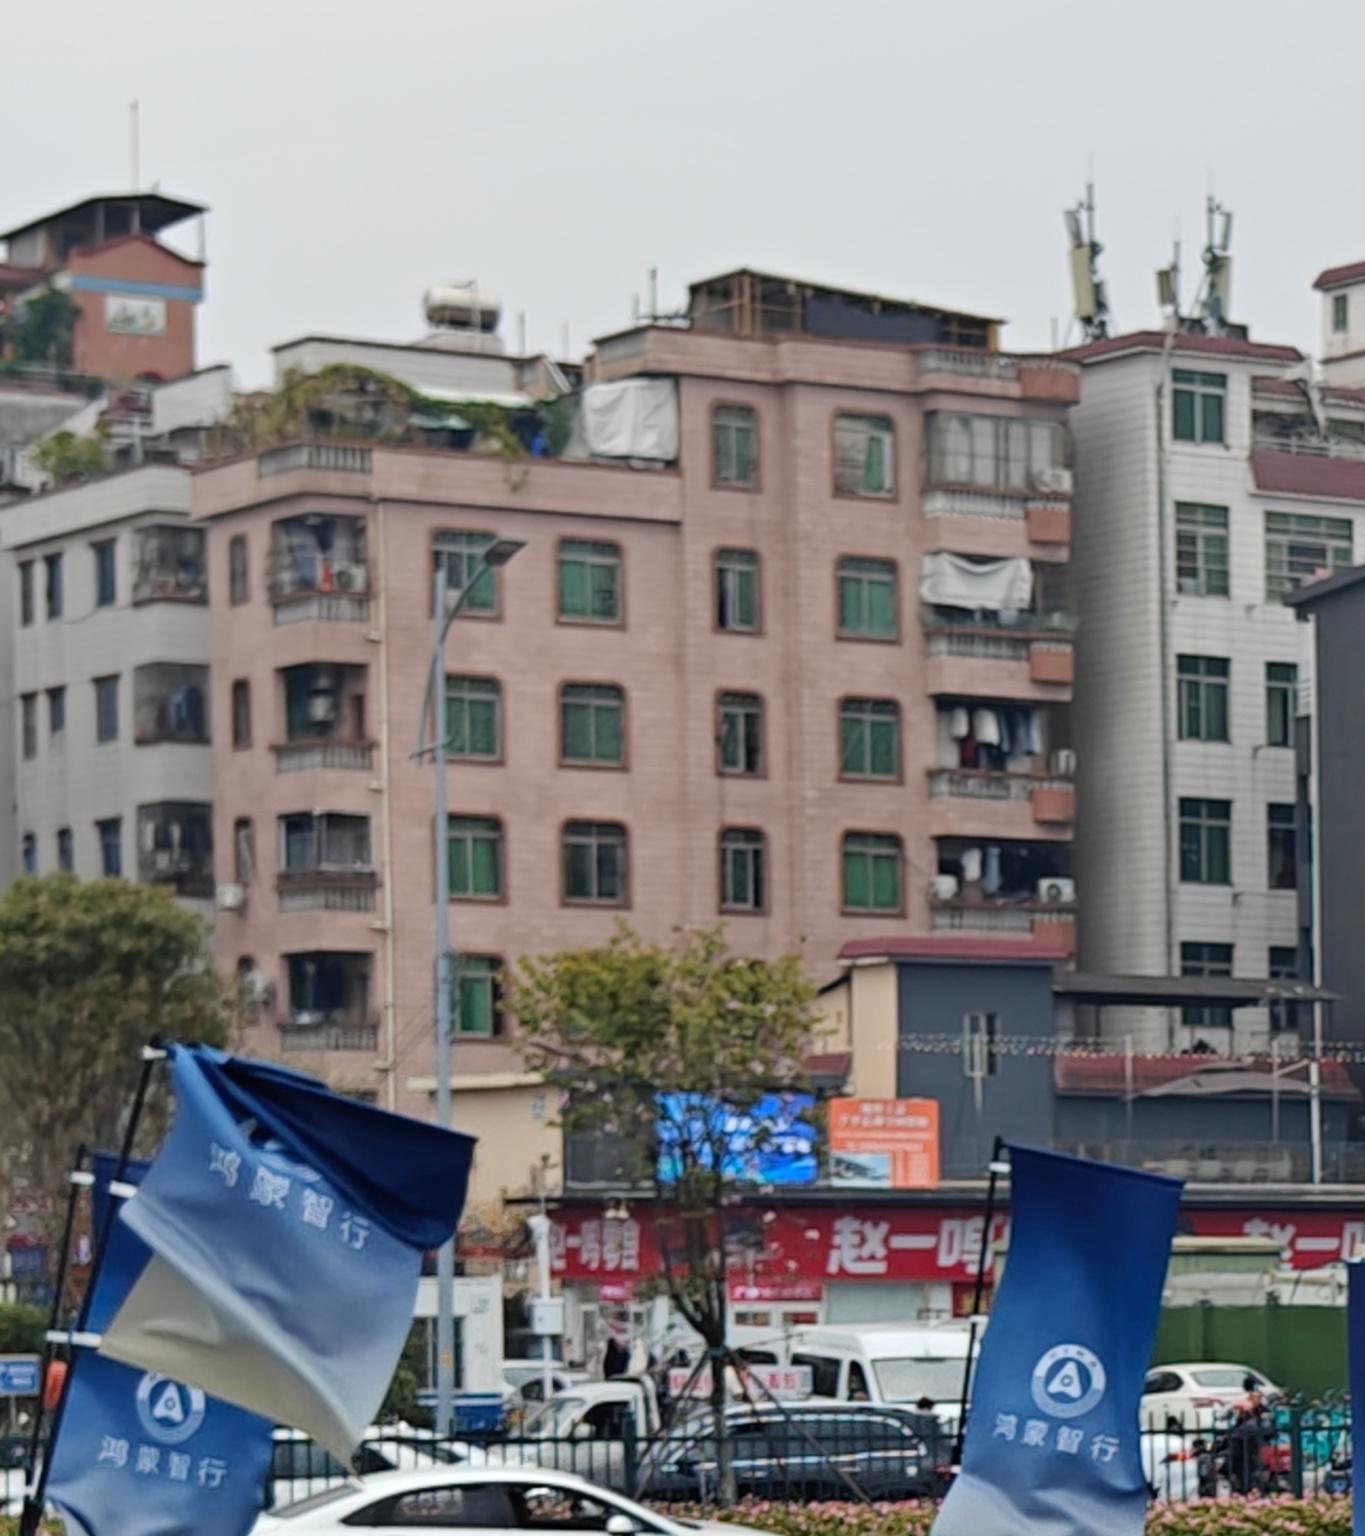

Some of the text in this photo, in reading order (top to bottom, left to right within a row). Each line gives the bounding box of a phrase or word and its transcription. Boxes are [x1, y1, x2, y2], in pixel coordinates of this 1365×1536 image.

[210, 1142, 370, 1251] 鸿蒙智行
[98, 1435, 228, 1488] 鸿蒙智行
[992, 1412, 1120, 1462] 鸿蒙智行
